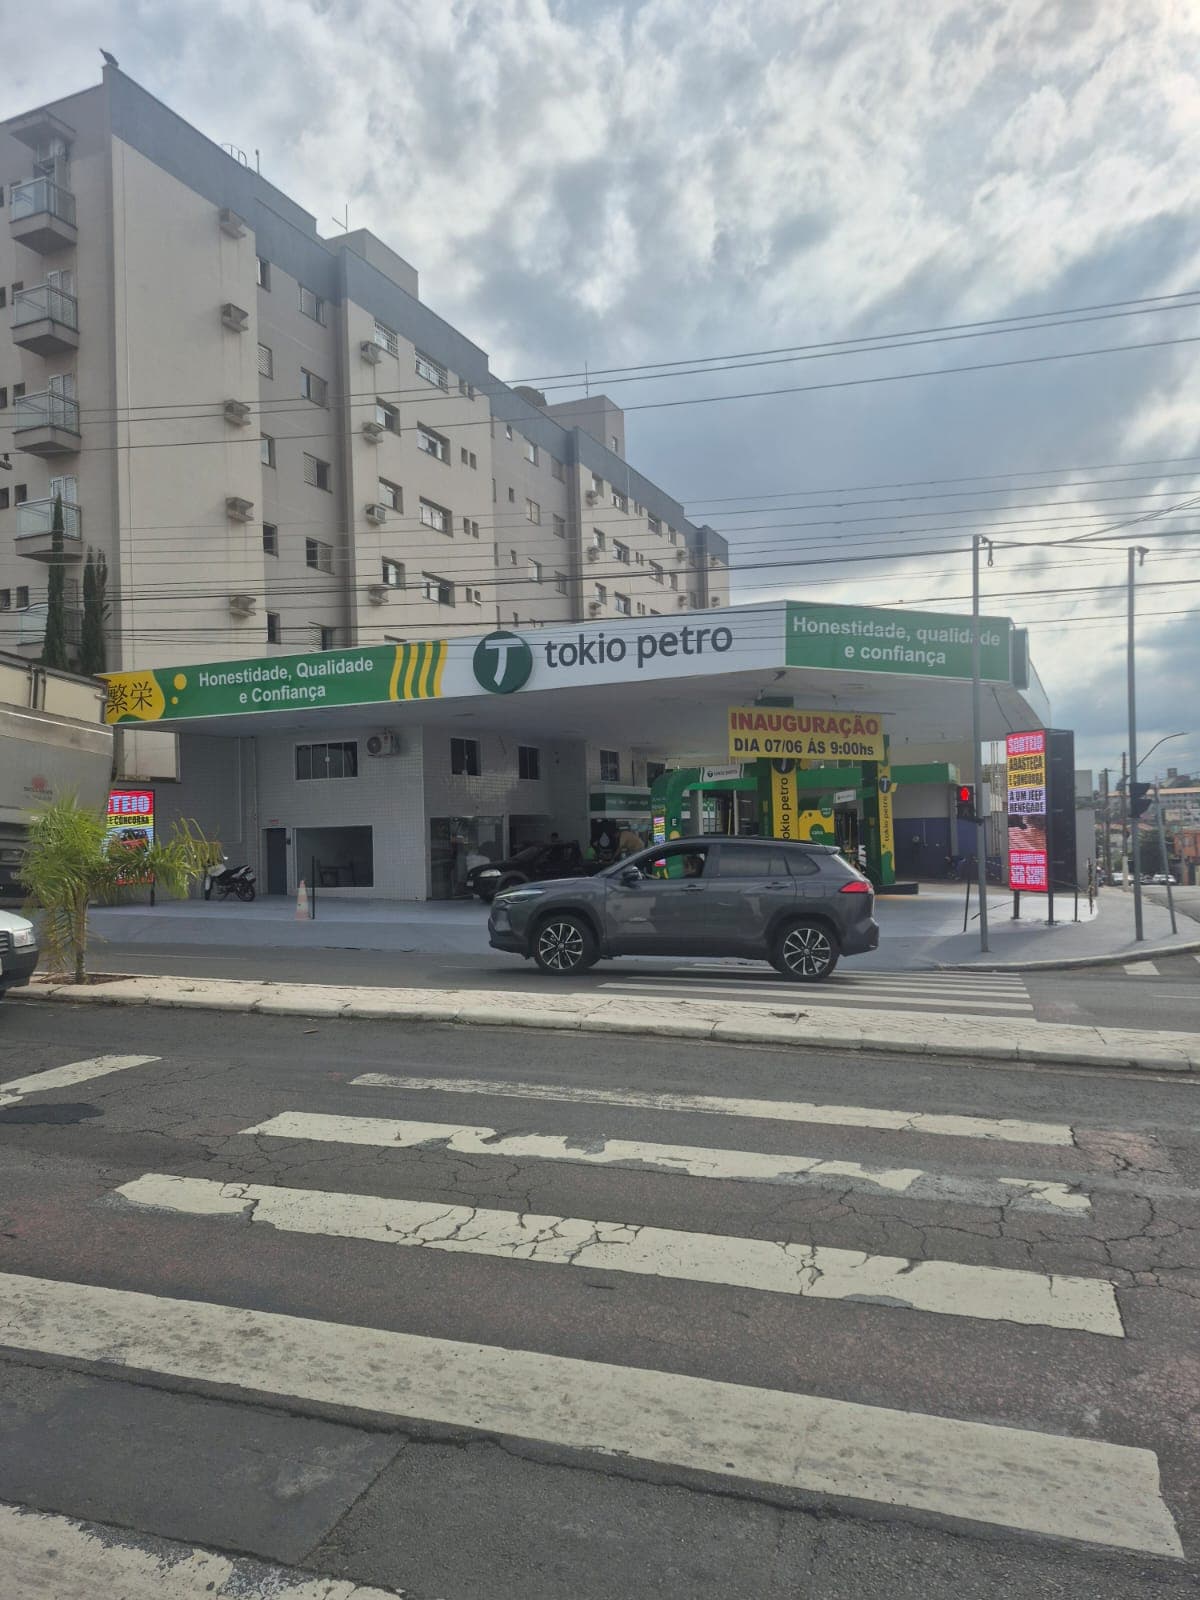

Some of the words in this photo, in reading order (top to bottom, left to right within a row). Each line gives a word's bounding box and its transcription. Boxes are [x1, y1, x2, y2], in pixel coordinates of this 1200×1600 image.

[793, 616, 911, 642] Honestidade,
[544, 632, 627, 668] tokio
[637, 625, 733, 668] petro
[844, 645, 855, 658] e
[860, 645, 946, 667] confiança
[199, 665, 292, 687] Honestidade,
[296, 657, 374, 678] Qualidade
[239, 690, 248, 704] e
[251, 683, 326, 704] Confiança
[730, 712, 880, 738] INAUGURAÇÃO
[734, 737, 760, 752] DIA
[764, 739, 803, 754] 07/06
[830, 741, 875, 756] 9:00hs
[780, 777, 792, 811] petro
[780, 814, 791, 841] okio
